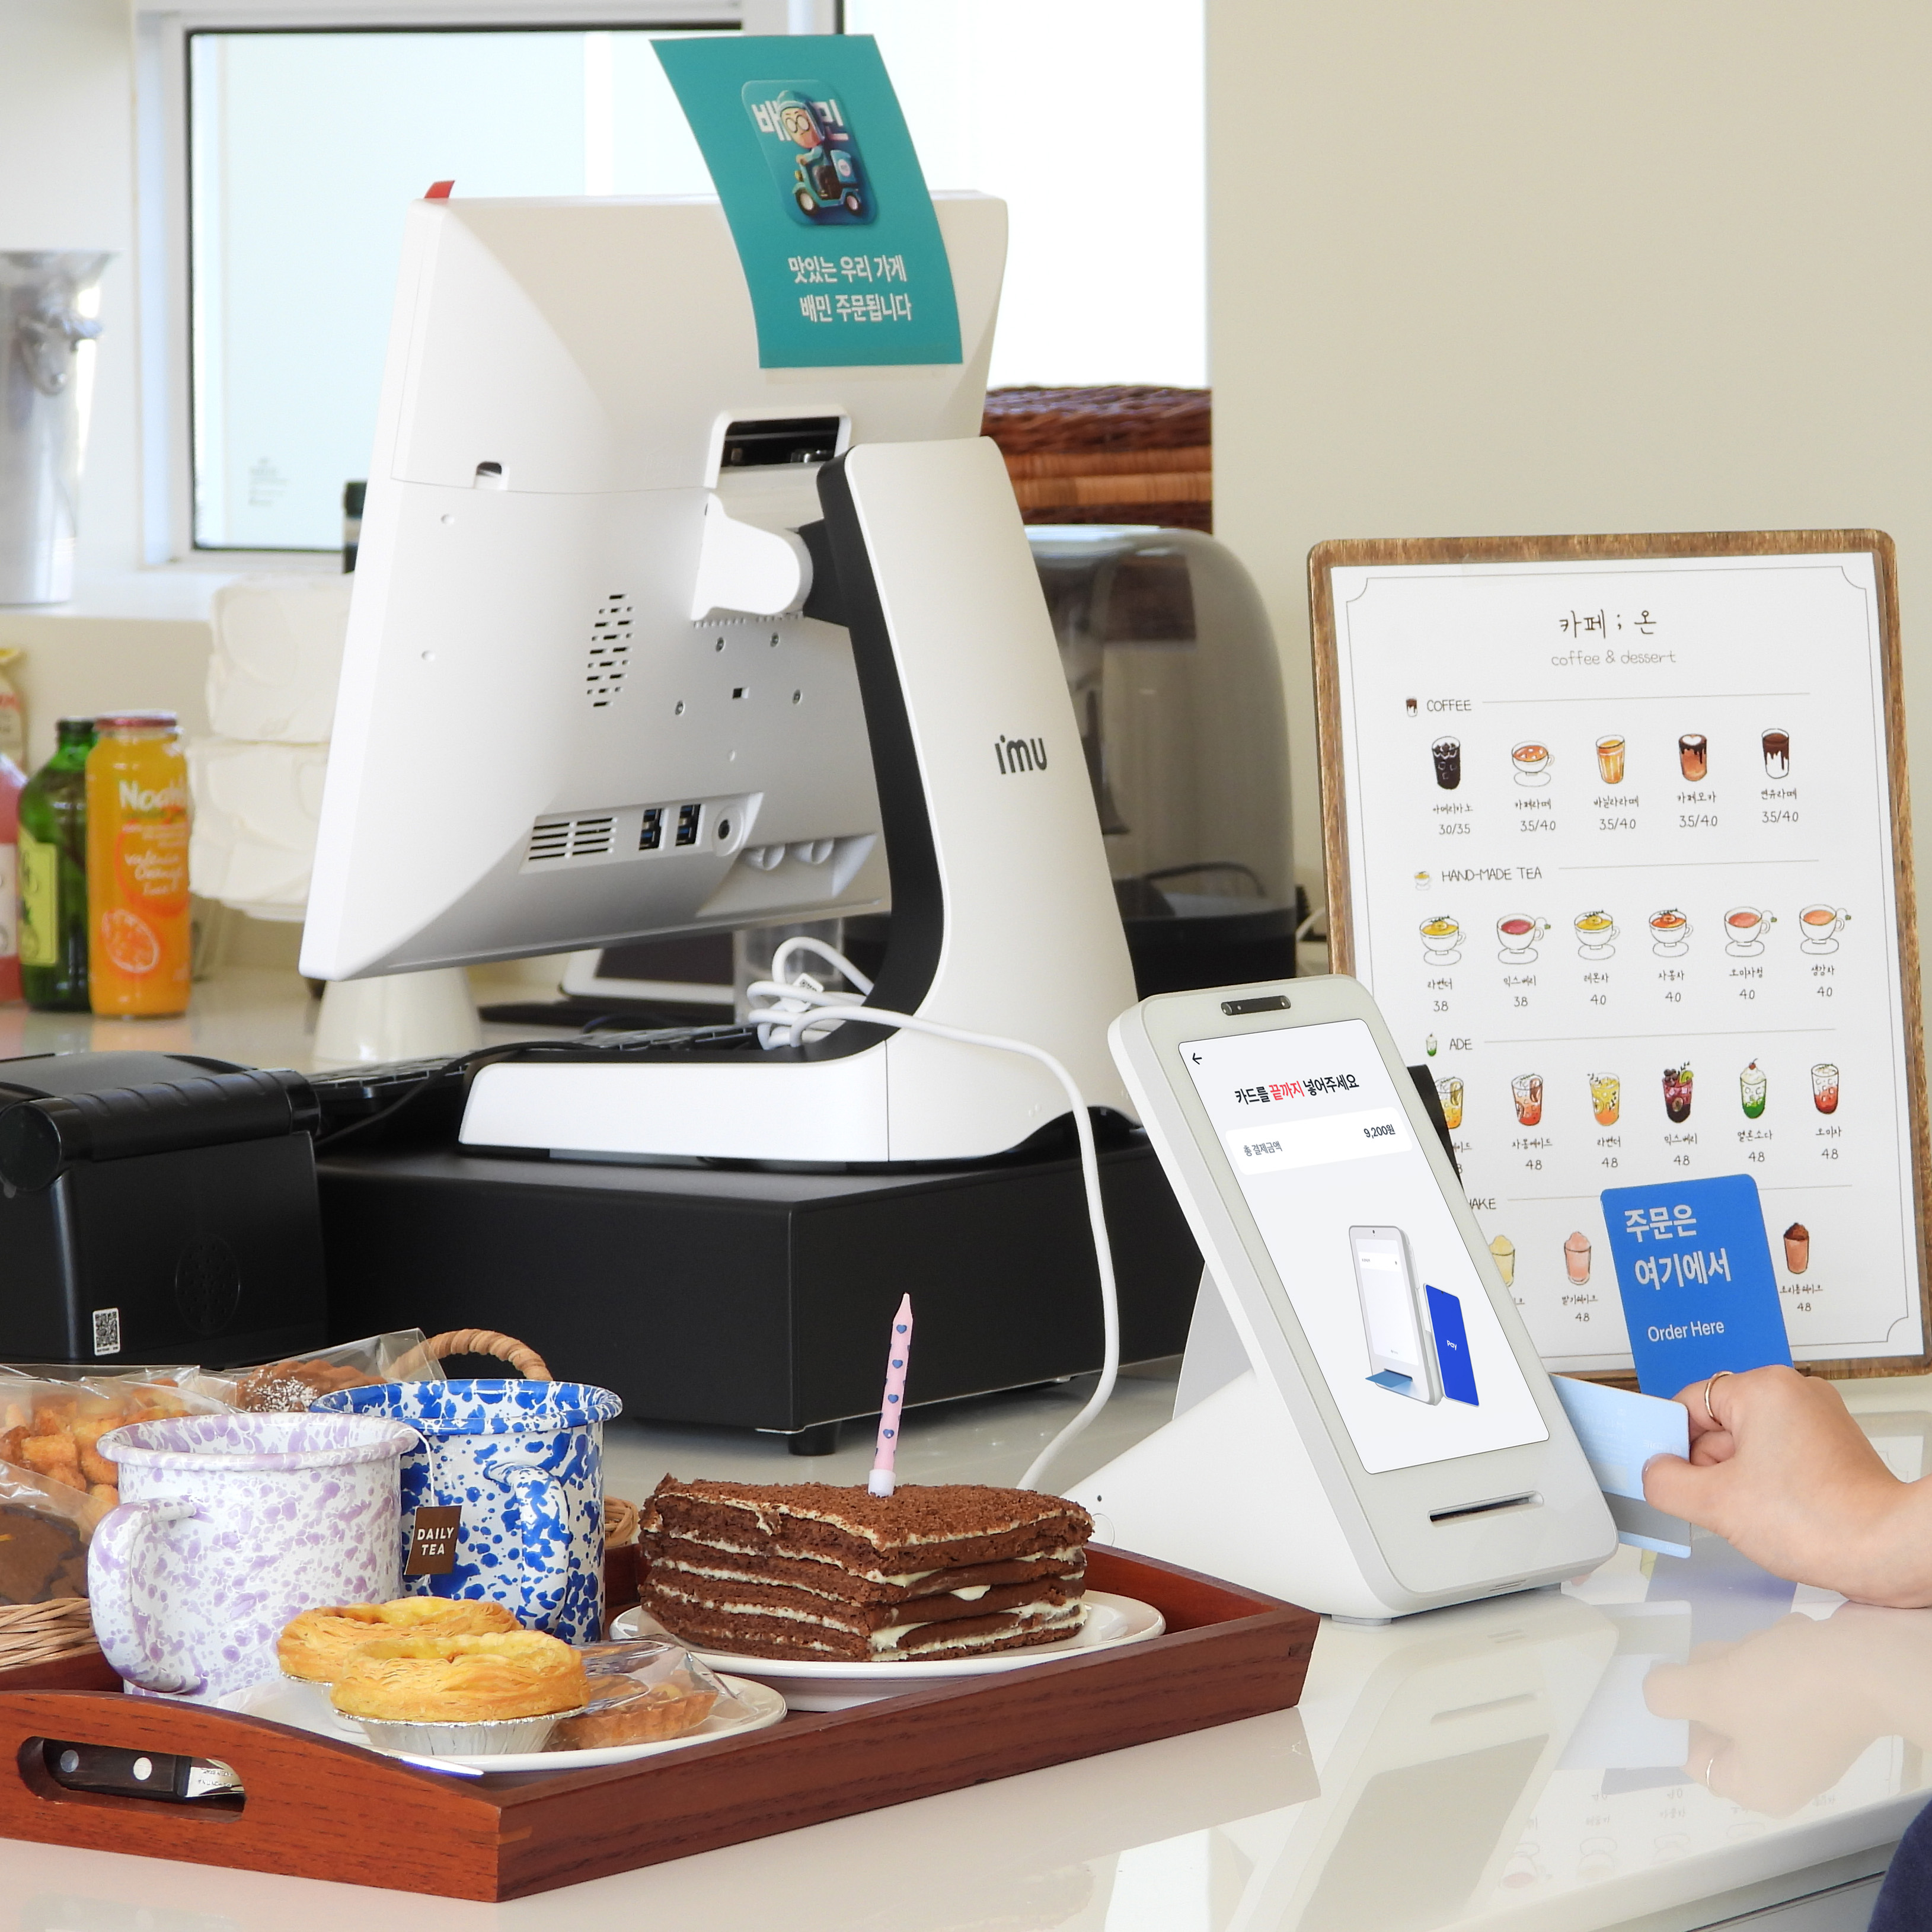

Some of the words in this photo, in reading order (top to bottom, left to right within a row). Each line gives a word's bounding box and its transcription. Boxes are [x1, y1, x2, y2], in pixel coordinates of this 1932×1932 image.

[787, 256, 838, 284] 맛있는
[840, 255, 873, 283] 우리
[874, 254, 907, 282] 가게
[800, 293, 833, 322] 배민
[835, 293, 912, 321] 주문됩니다
[1559, 609, 1606, 639] 카페
[1634, 609, 1657, 635] 온
[1551, 650, 1601, 666] coffee
[1605, 649, 1616, 664] &
[1620, 650, 1676, 664] dessert
[1426, 699, 1472, 712] COFFEE
[1442, 868, 1512, 882] HAND-MADE
[1516, 866, 1543, 880] TEA
[1449, 1038, 1473, 1050] ADE
[1234, 1086, 1271, 1105] 카드를
[1269, 1080, 1305, 1101] 끝까지
[1302, 1074, 1360, 1097] 넣어주세요
[1363, 1123, 1396, 1139] 9,200원
[1243, 1145, 1252, 1157] 총
[1252, 1141, 1283, 1155] 결제금액
[1624, 1204, 1697, 1243] 주문은
[1634, 1247, 1732, 1291] 여기에서
[1647, 1324, 1688, 1342] Order
[1690, 1320, 1725, 1337] Here
[1446, 1340, 1457, 1351] Pay
[417, 1527, 454, 1541] DAILY
[421, 1543, 445, 1556] TEA
